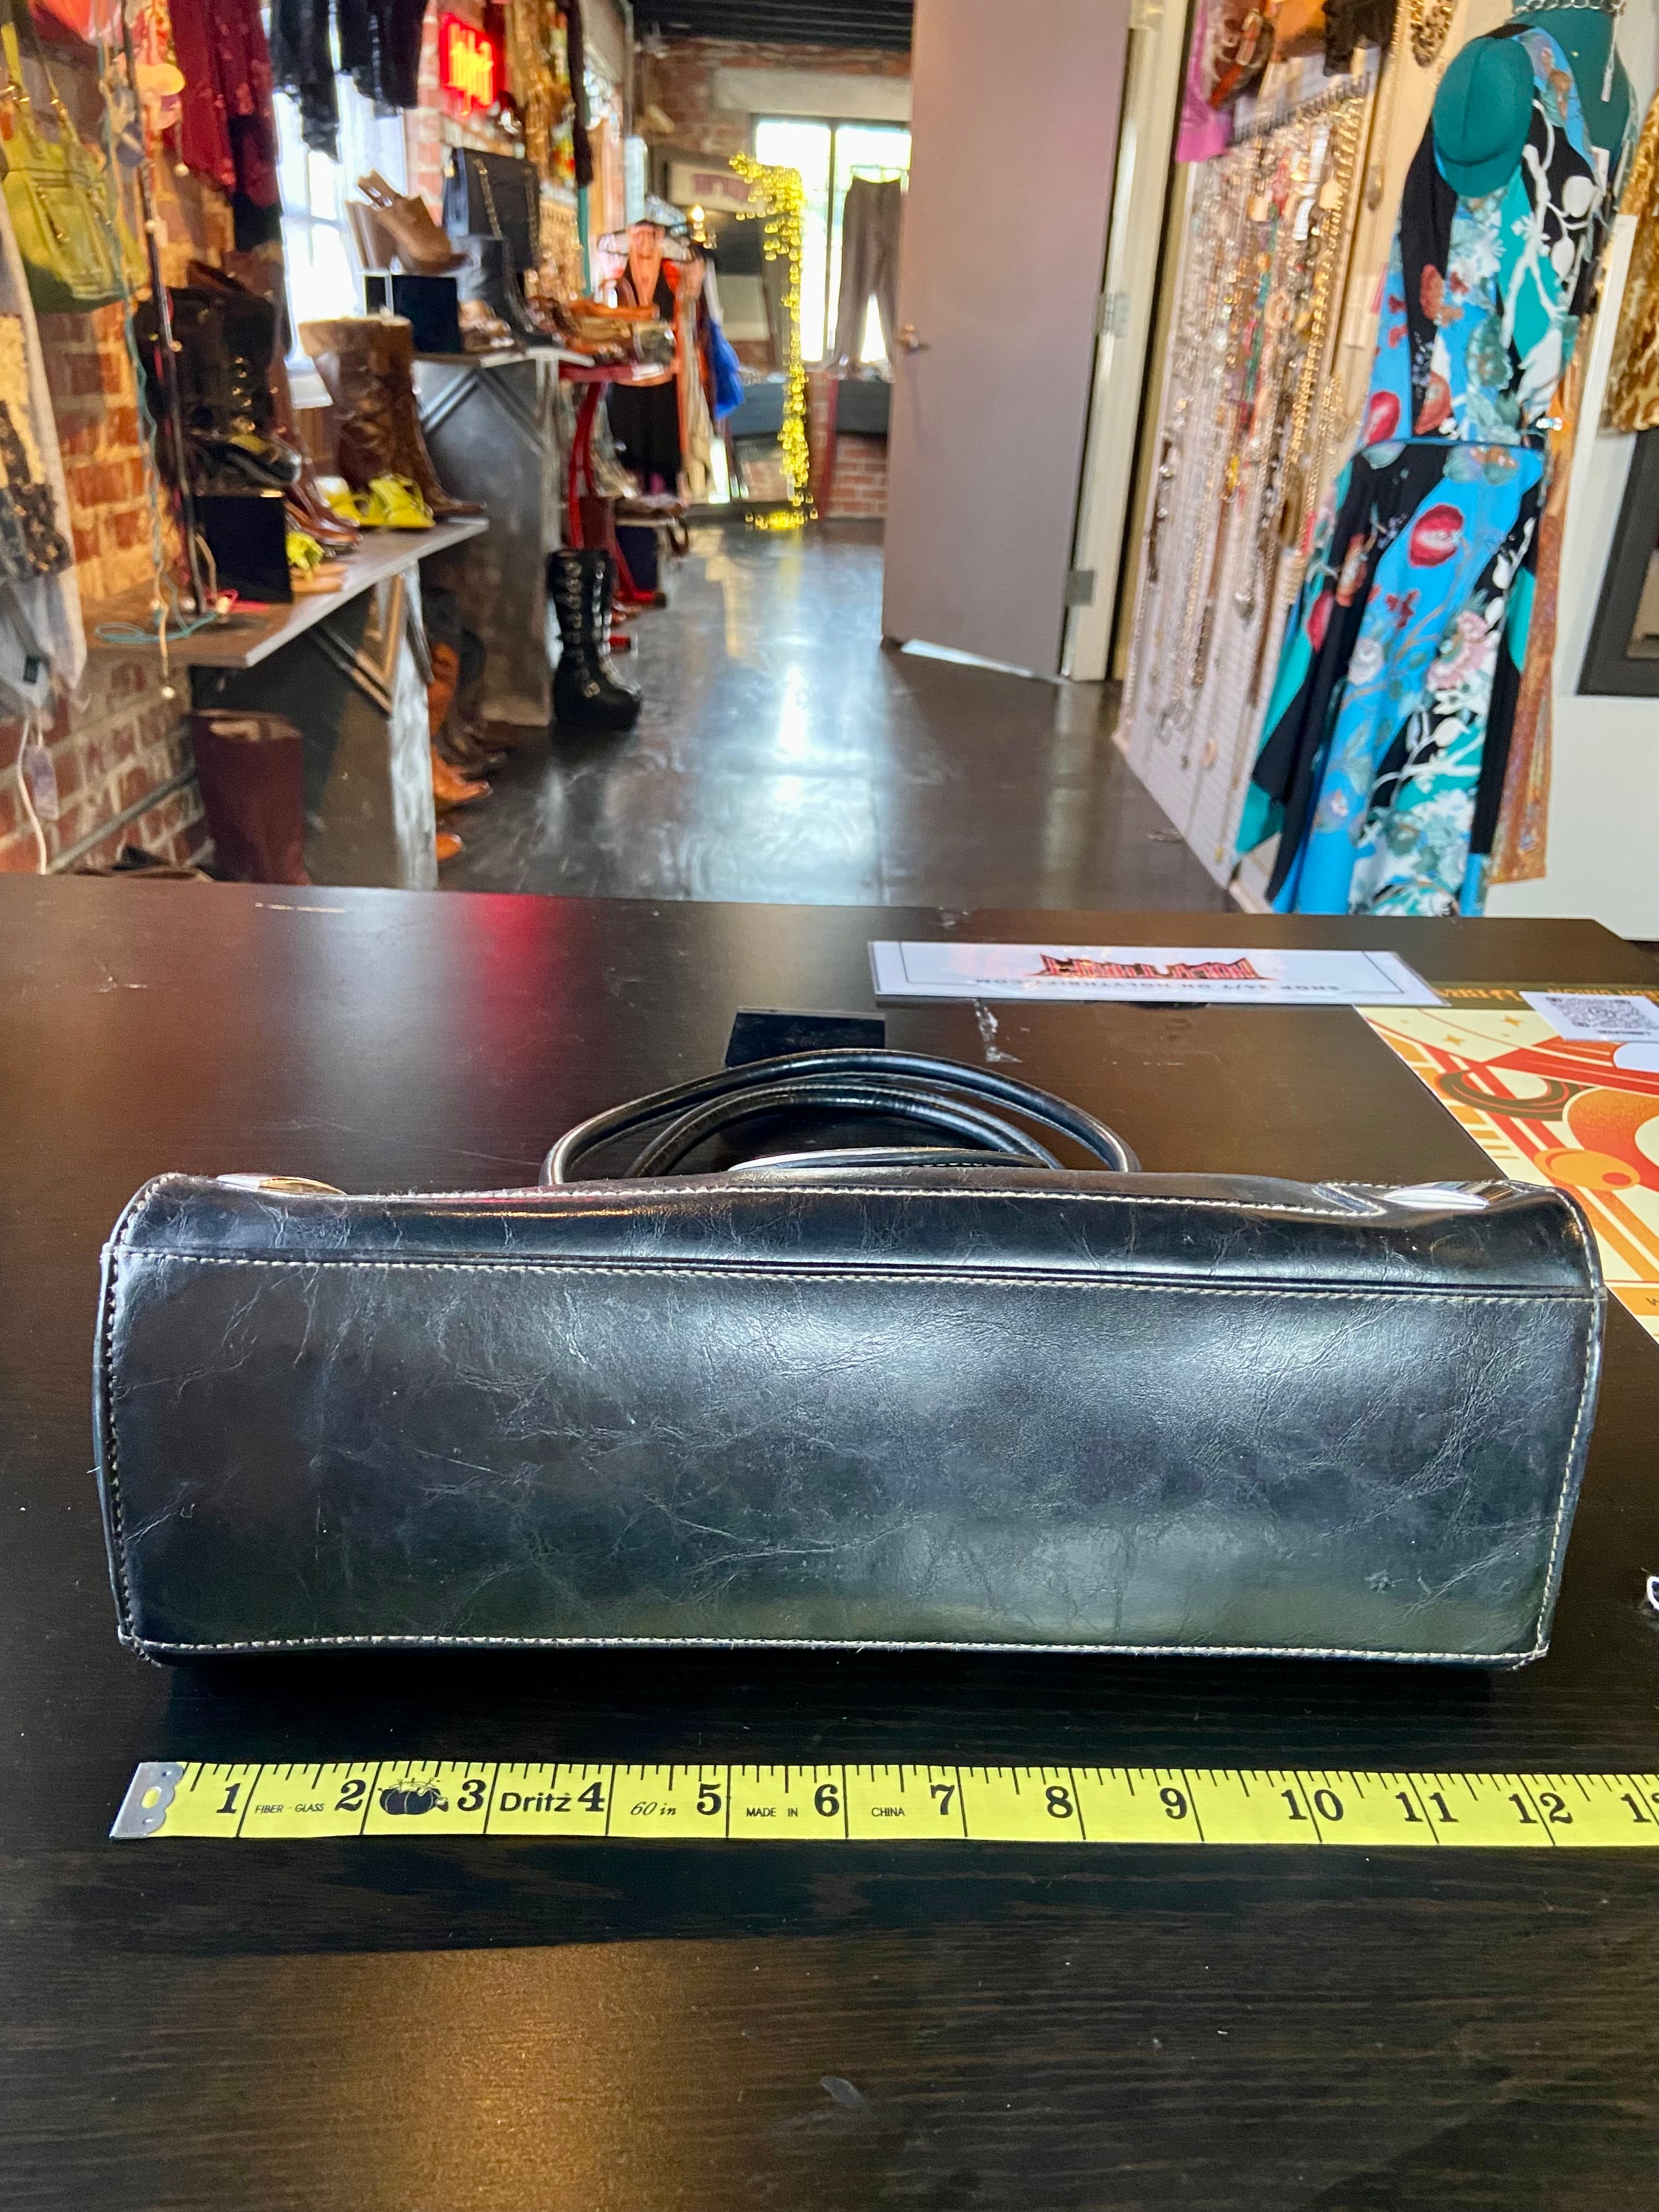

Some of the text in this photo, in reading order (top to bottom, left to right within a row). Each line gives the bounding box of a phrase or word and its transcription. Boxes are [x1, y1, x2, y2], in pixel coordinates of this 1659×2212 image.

[216, 1783, 241, 1814] 1
[254, 1805, 284, 1814] FIBER
[295, 1803, 325, 1812] GLASS
[334, 1779, 366, 1811] 2
[457, 1779, 486, 1812] 3
[500, 1792, 572, 1812] Dritz
[578, 1782, 605, 1812] 4
[630, 1801, 676, 1815] 60 in
[697, 1783, 721, 1815] 5
[814, 1784, 839, 1816] 6
[930, 1784, 955, 1815] 7
[1045, 1786, 1073, 1818] 8
[1159, 1787, 1187, 1820] 9
[1281, 1788, 1344, 1821] 10
[1395, 1791, 1459, 1822] 11
[1509, 1792, 1573, 1824] 12
[1621, 1792, 1659, 1823] 1
[746, 1807, 799, 1817] MADE IN
[871, 1807, 905, 1817] CHINA
